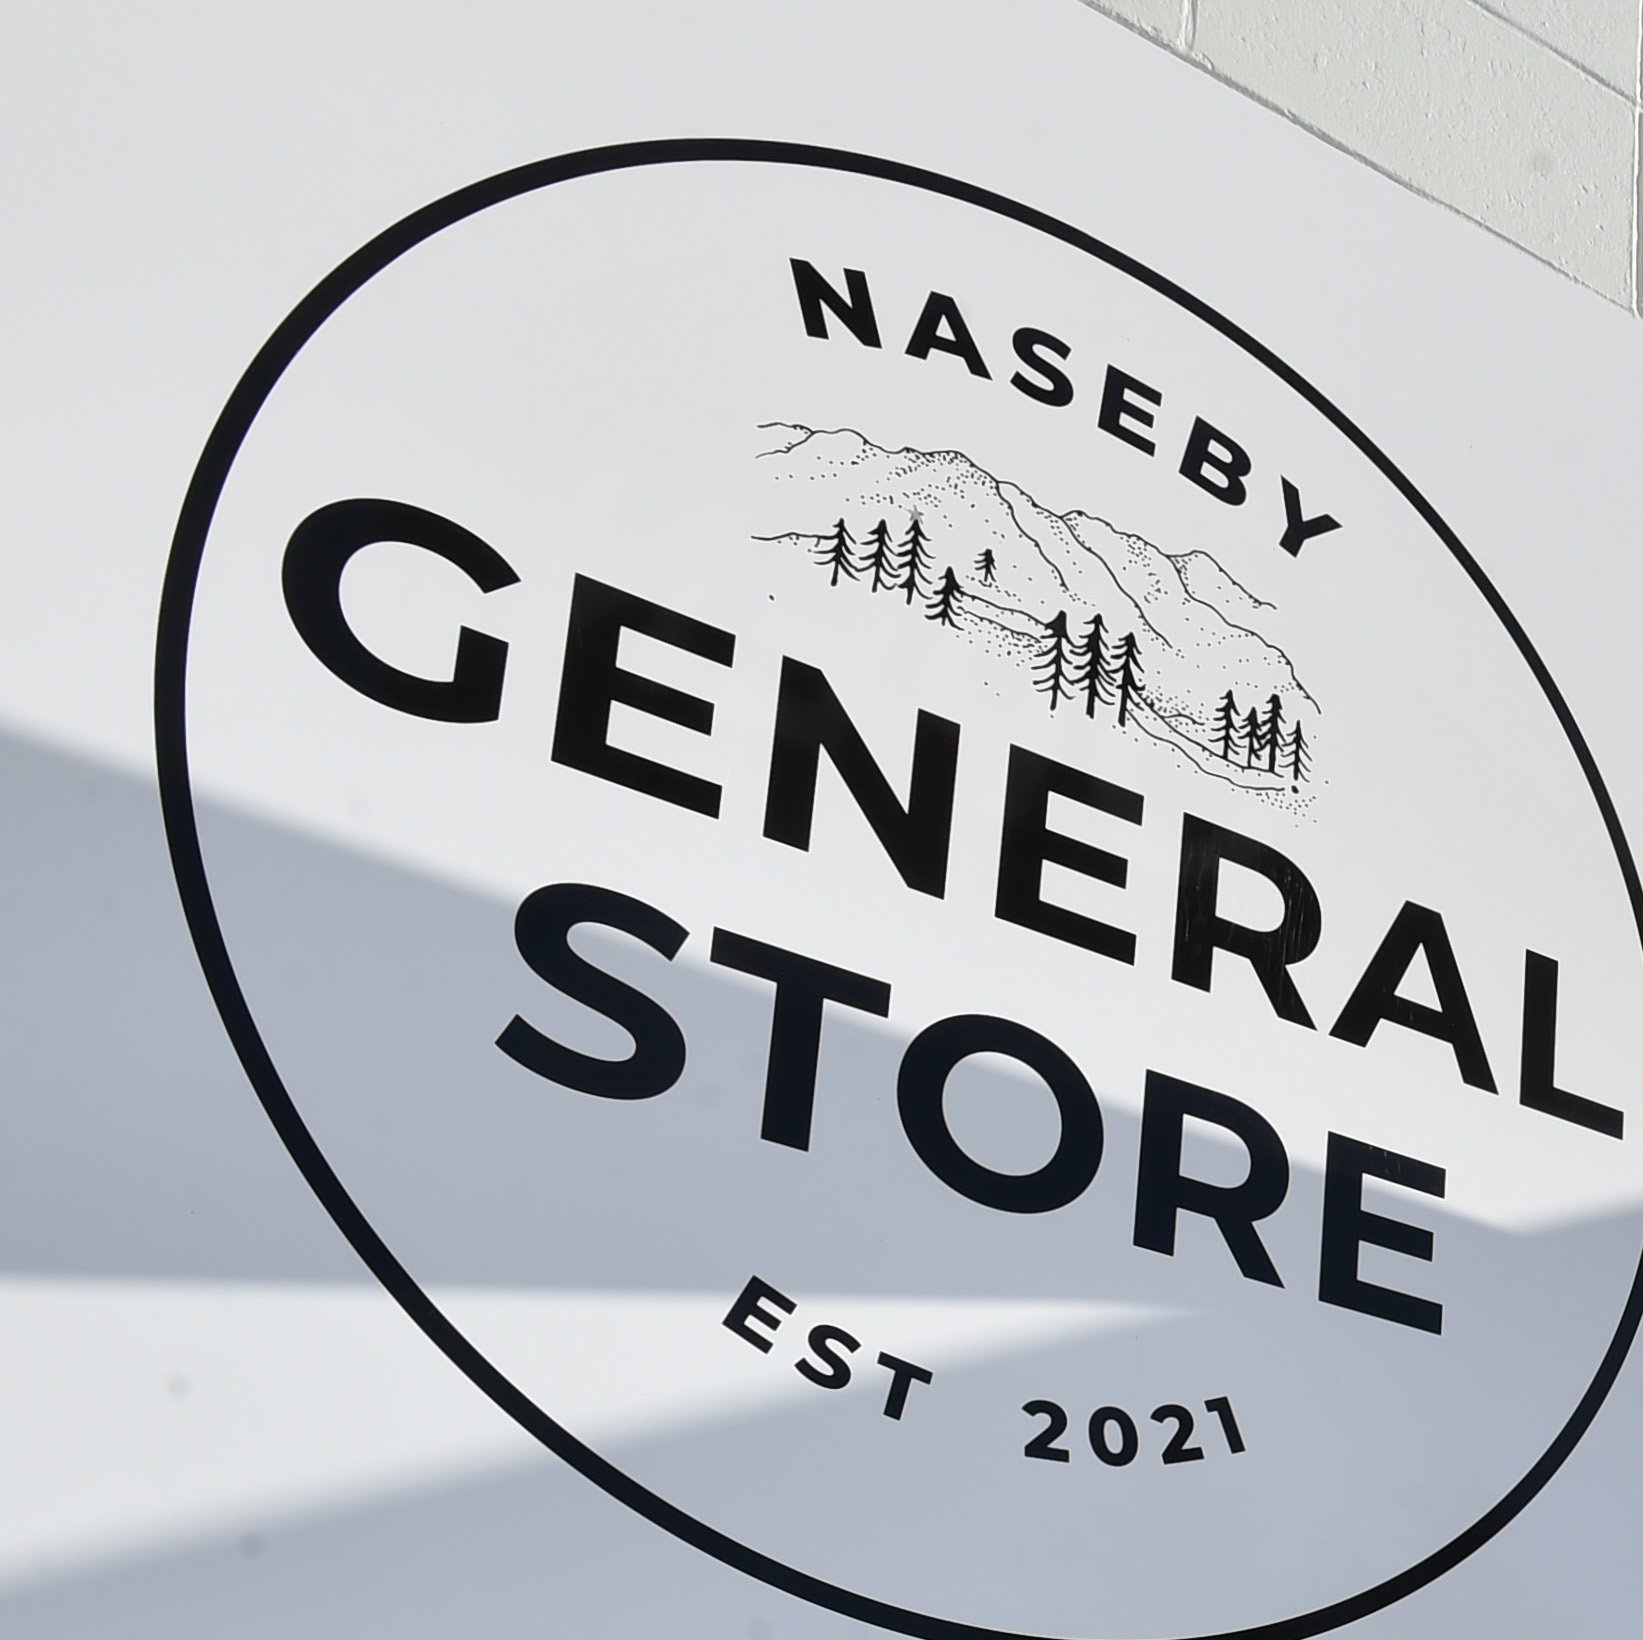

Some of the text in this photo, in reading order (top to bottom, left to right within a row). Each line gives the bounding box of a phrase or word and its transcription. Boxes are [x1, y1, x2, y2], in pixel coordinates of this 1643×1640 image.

[790, 259, 1342, 558] NASEBY
[282, 499, 1624, 1140] GENERAL
[495, 883, 1446, 1335] STORE
[723, 1276, 1246, 1467] EST 2021
